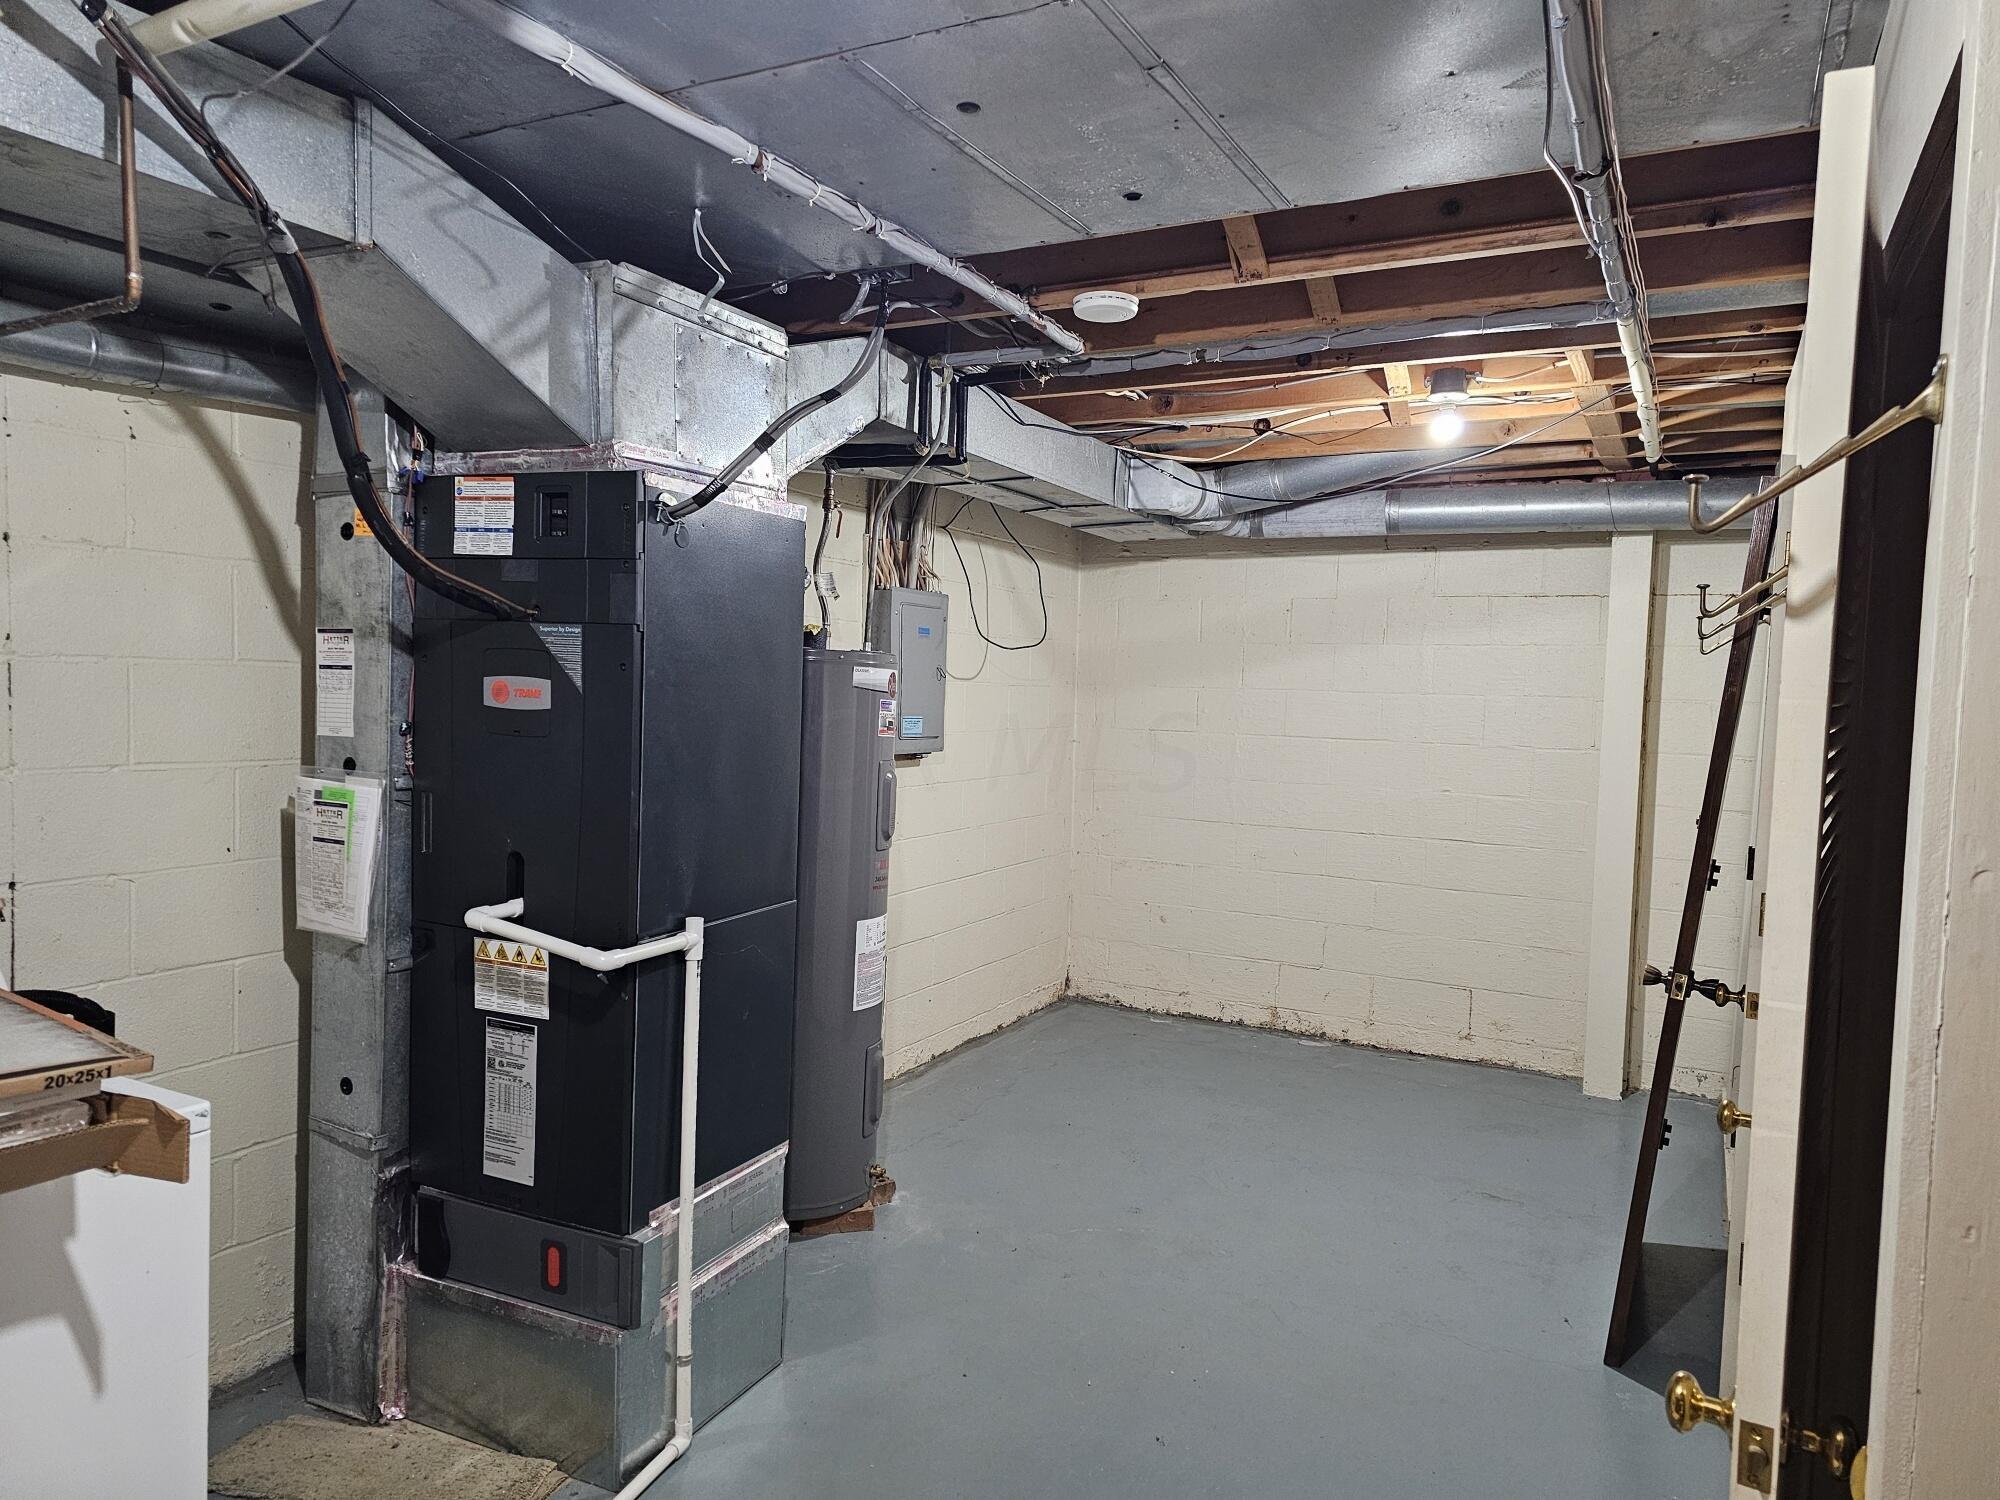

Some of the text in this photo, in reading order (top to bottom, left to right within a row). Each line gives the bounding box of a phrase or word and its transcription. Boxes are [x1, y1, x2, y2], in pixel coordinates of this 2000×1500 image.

[540, 625, 558, 633] Superior
[565, 626, 581, 634] Design
[44, 1065, 112, 1090] 20x25x1
